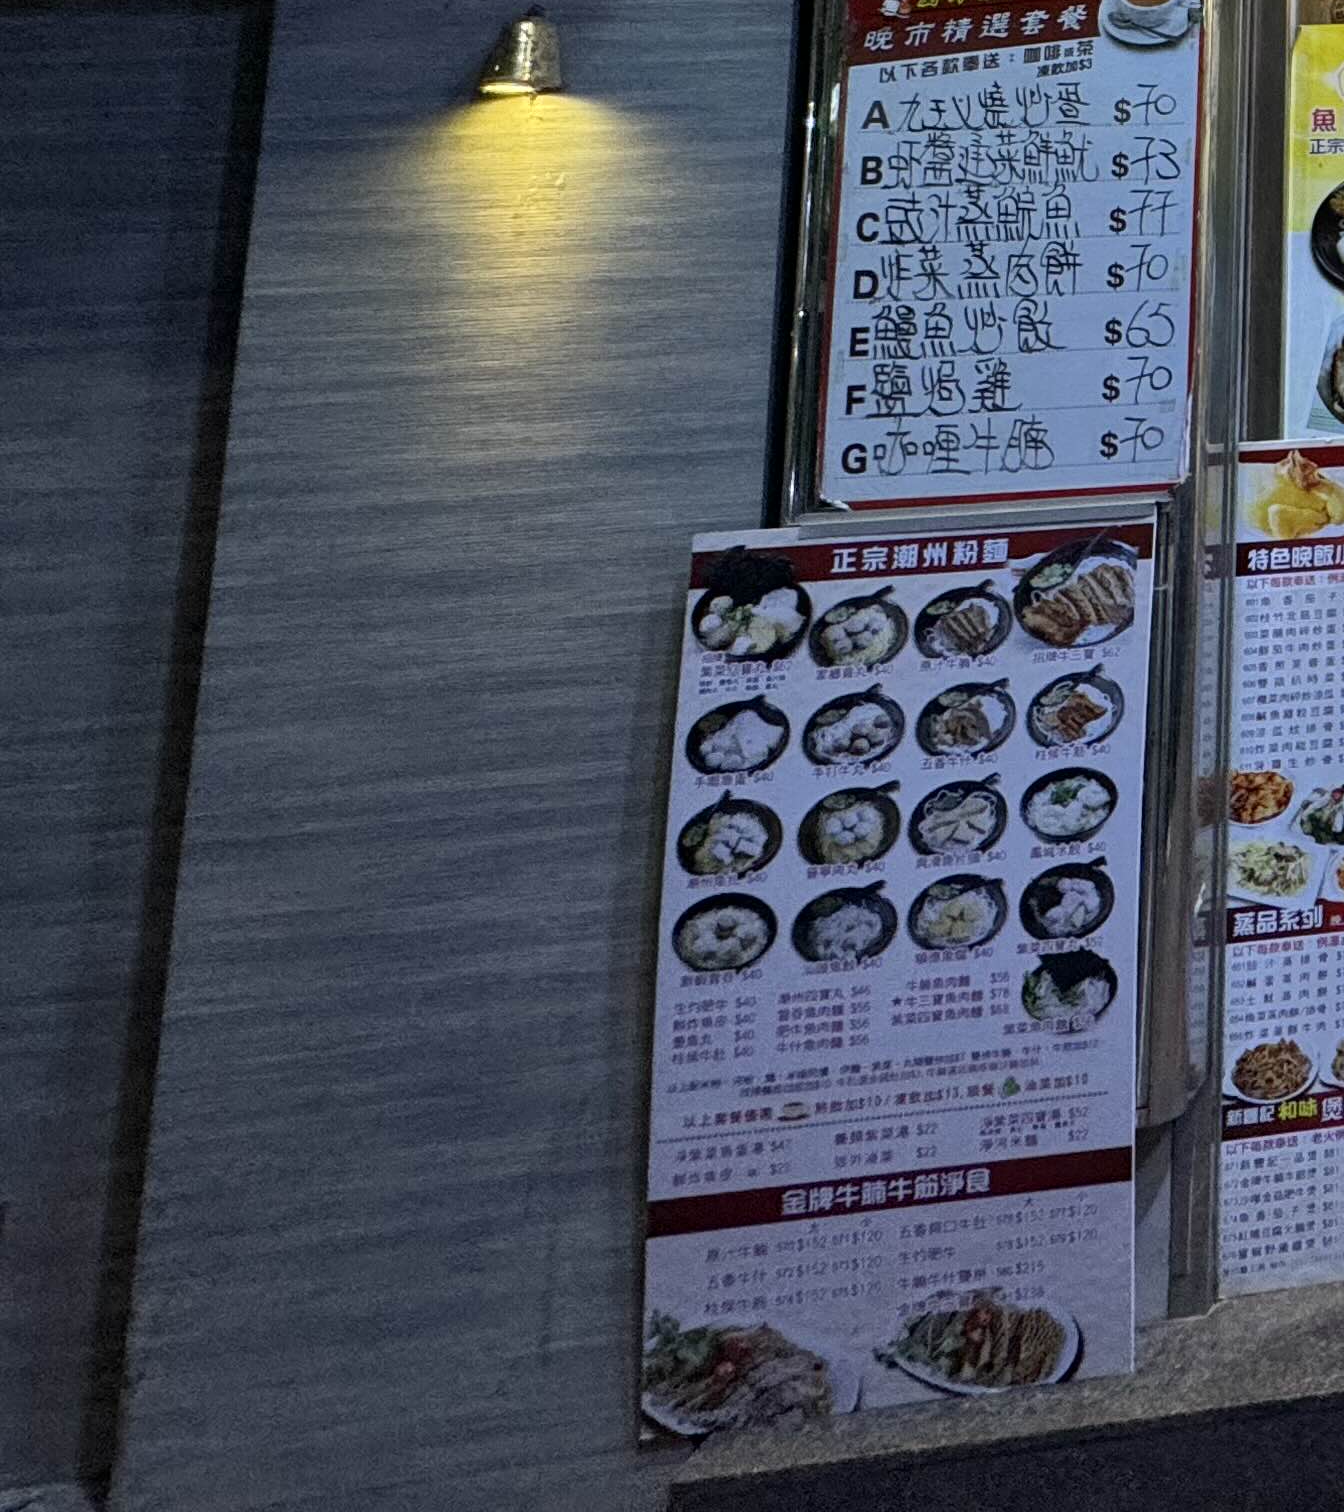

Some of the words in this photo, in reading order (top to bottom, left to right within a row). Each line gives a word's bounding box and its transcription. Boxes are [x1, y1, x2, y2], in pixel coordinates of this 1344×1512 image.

[864, 4, 1089, 51] 晚市精選套餐
[862, 100, 890, 129] A
[860, 155, 884, 185] B
[856, 212, 880, 242] C
[853, 270, 879, 300] D
[850, 327, 870, 357] E
[845, 385, 866, 416] F
[841, 442, 868, 475] G
[831, 538, 1009, 574] 正宗潮州粉麵
[1232, 904, 1324, 938] 蒸品系列
[782, 1168, 992, 1217] 金牌牛腩牛筋淨食
